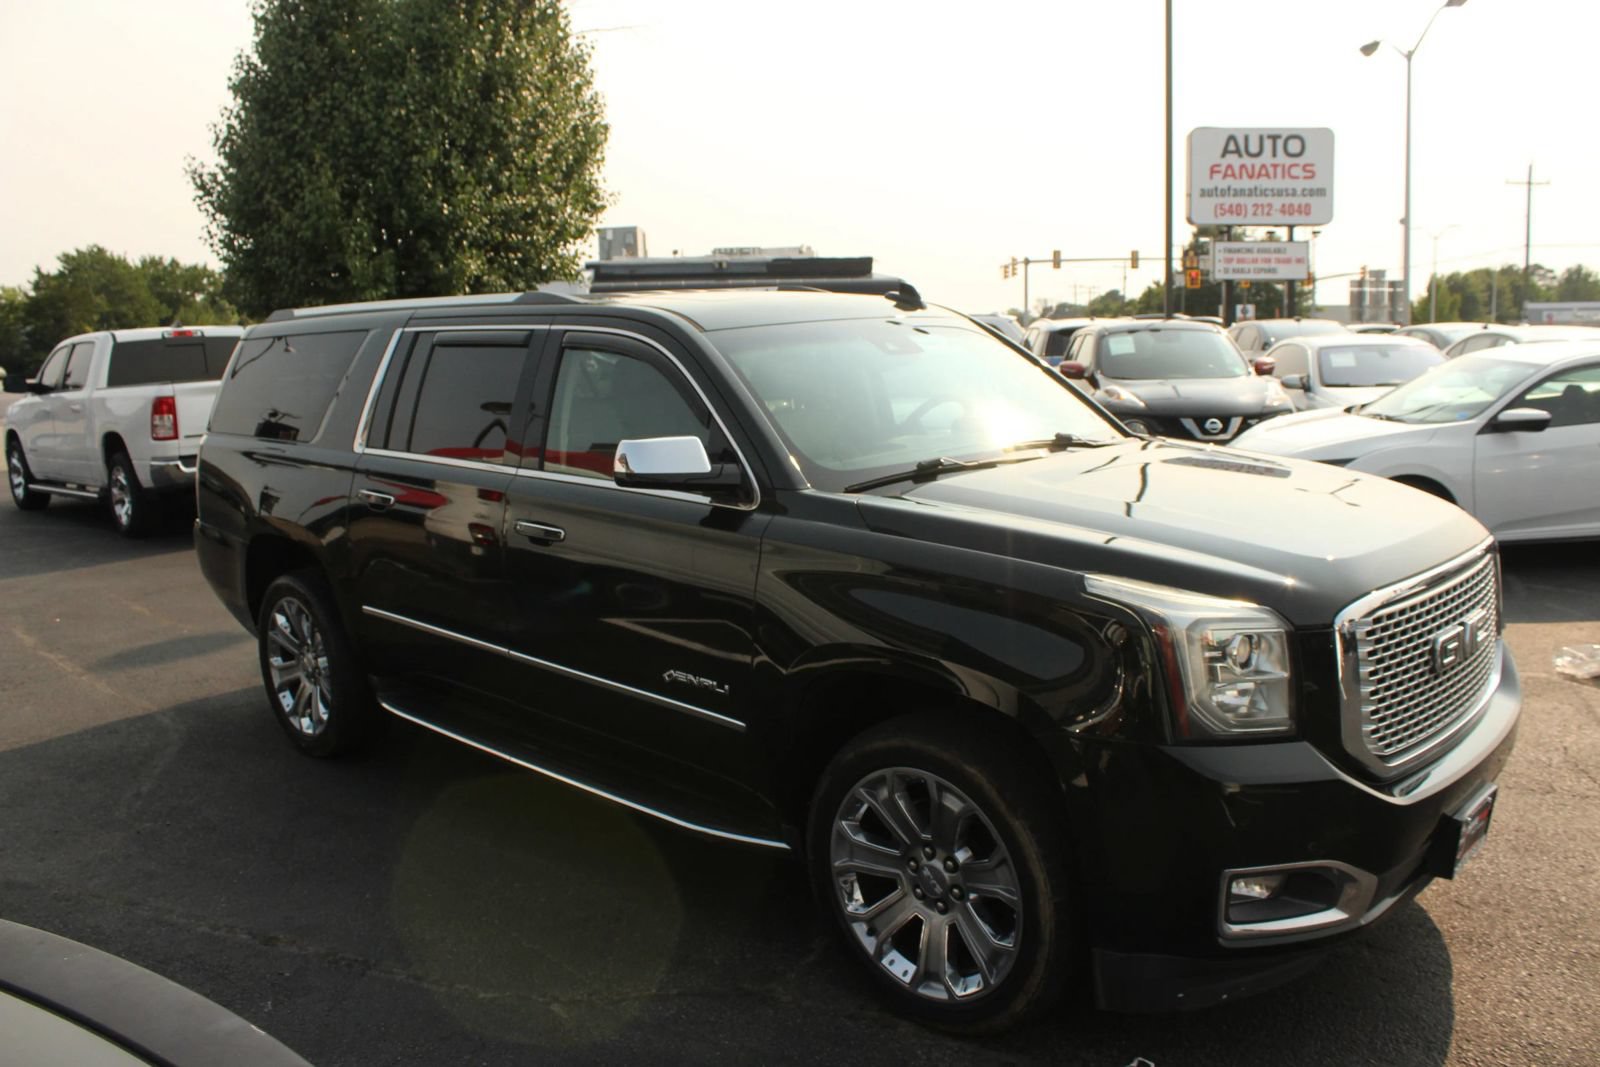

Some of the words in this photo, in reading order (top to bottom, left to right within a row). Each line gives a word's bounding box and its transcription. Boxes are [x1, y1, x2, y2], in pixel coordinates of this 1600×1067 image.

[1221, 134, 1306, 158] AUTO
[1209, 163, 1316, 180] FANATICS
[1199, 185, 1327, 197] autofanaticsusa.com
[1213, 202, 1248, 218] (540)
[1251, 202, 1312, 217] 212-4040
